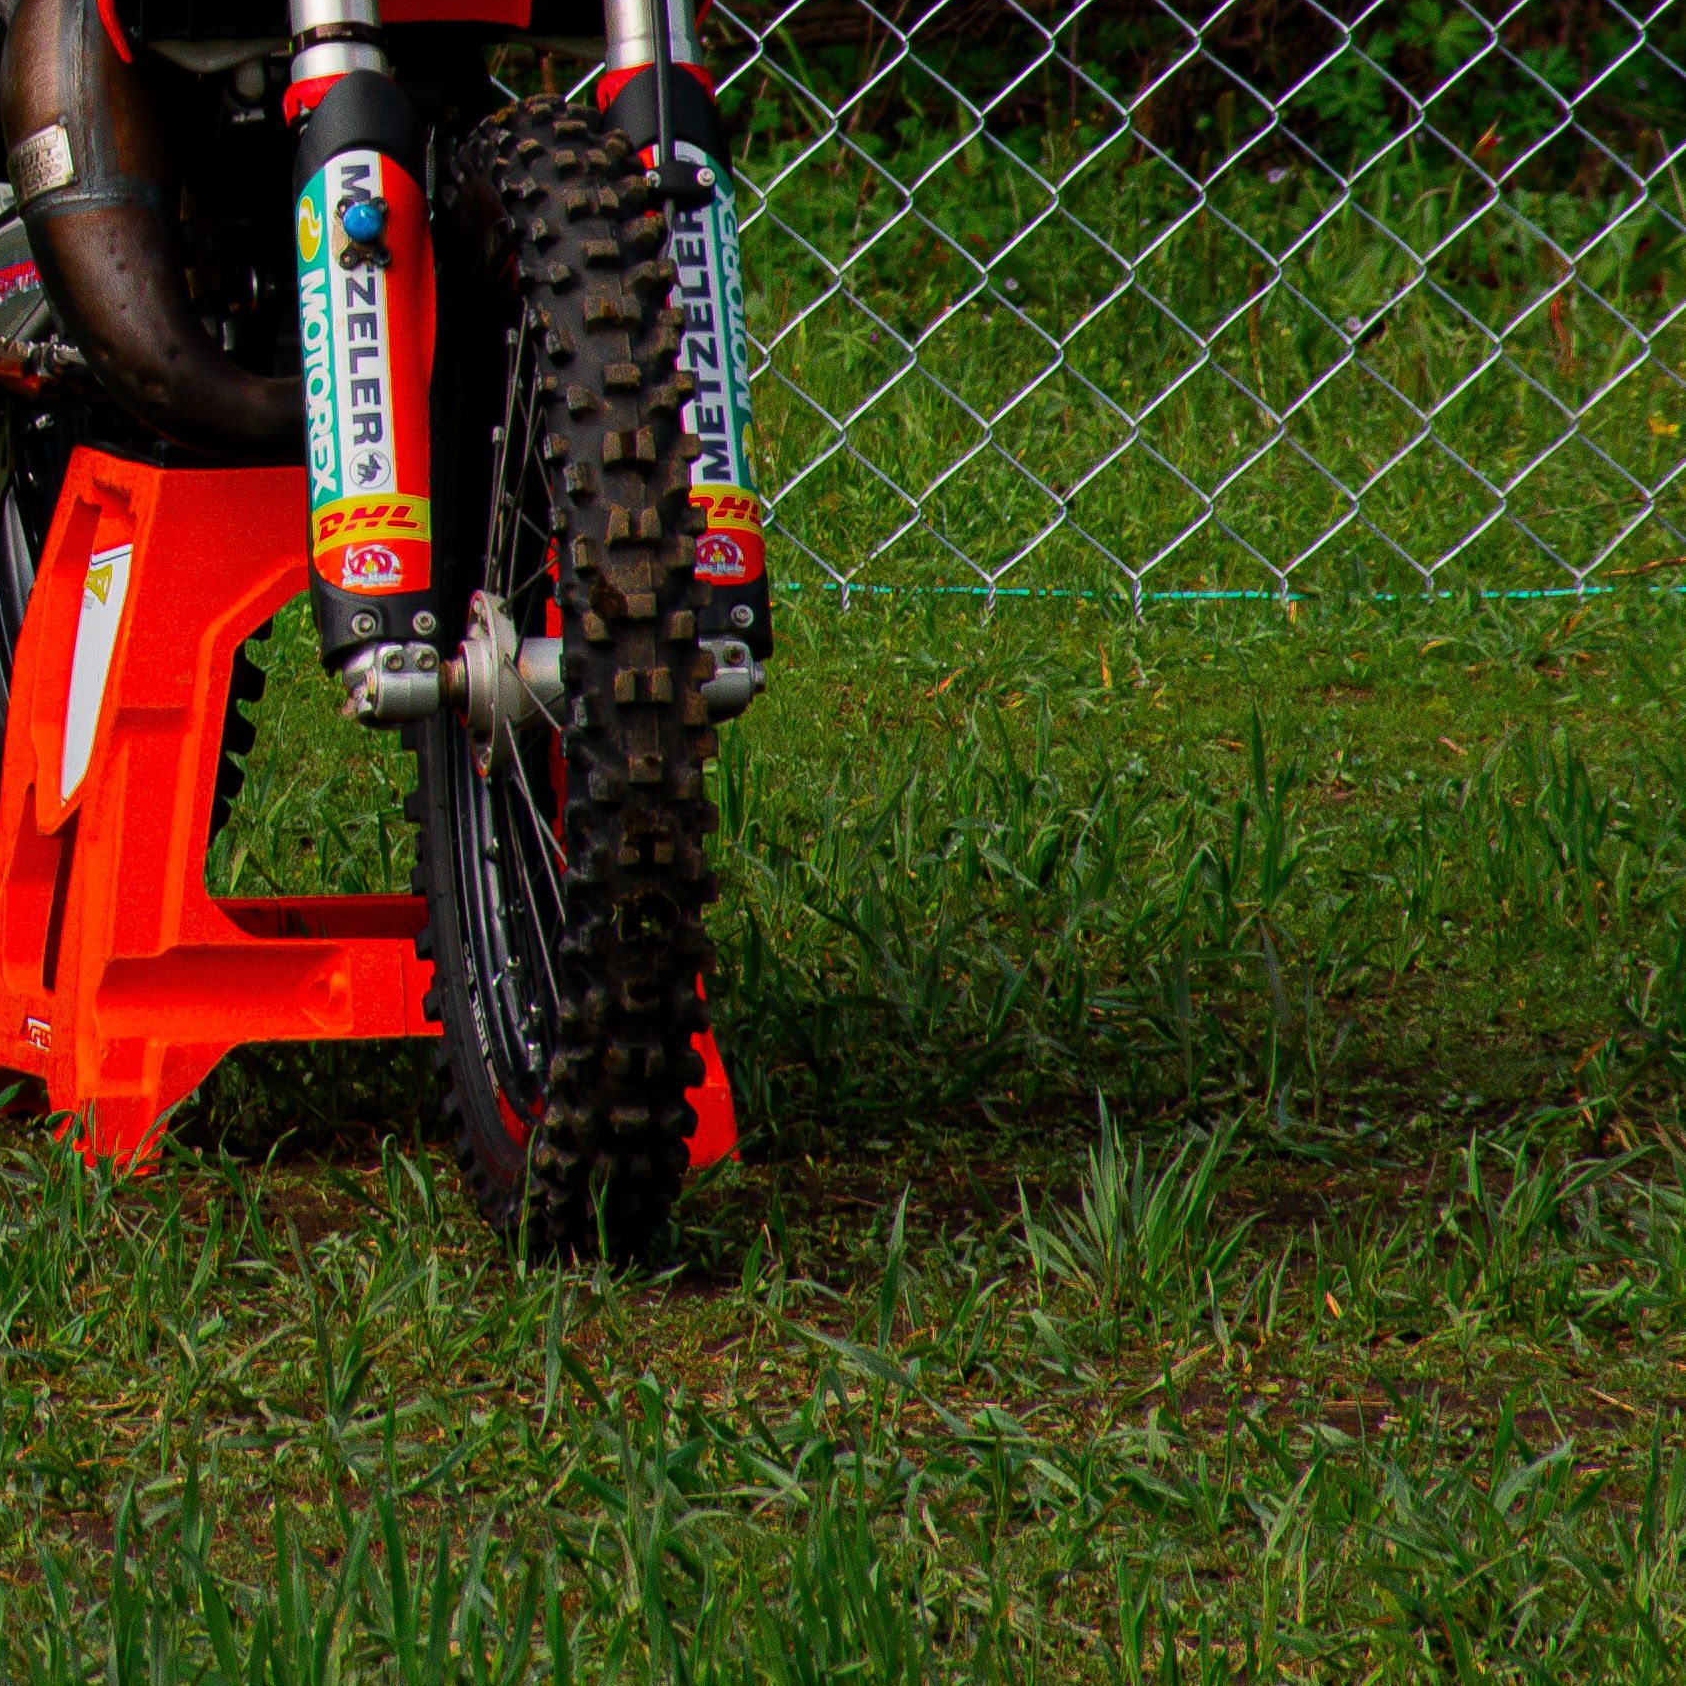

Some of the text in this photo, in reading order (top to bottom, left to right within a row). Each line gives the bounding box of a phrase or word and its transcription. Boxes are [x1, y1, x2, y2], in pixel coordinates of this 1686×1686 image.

[300, 267, 337, 503] MOTOREX
[341, 164, 383, 446] MZELER
[715, 190, 753, 413] MOTOREX
[318, 504, 418, 543] DHL
